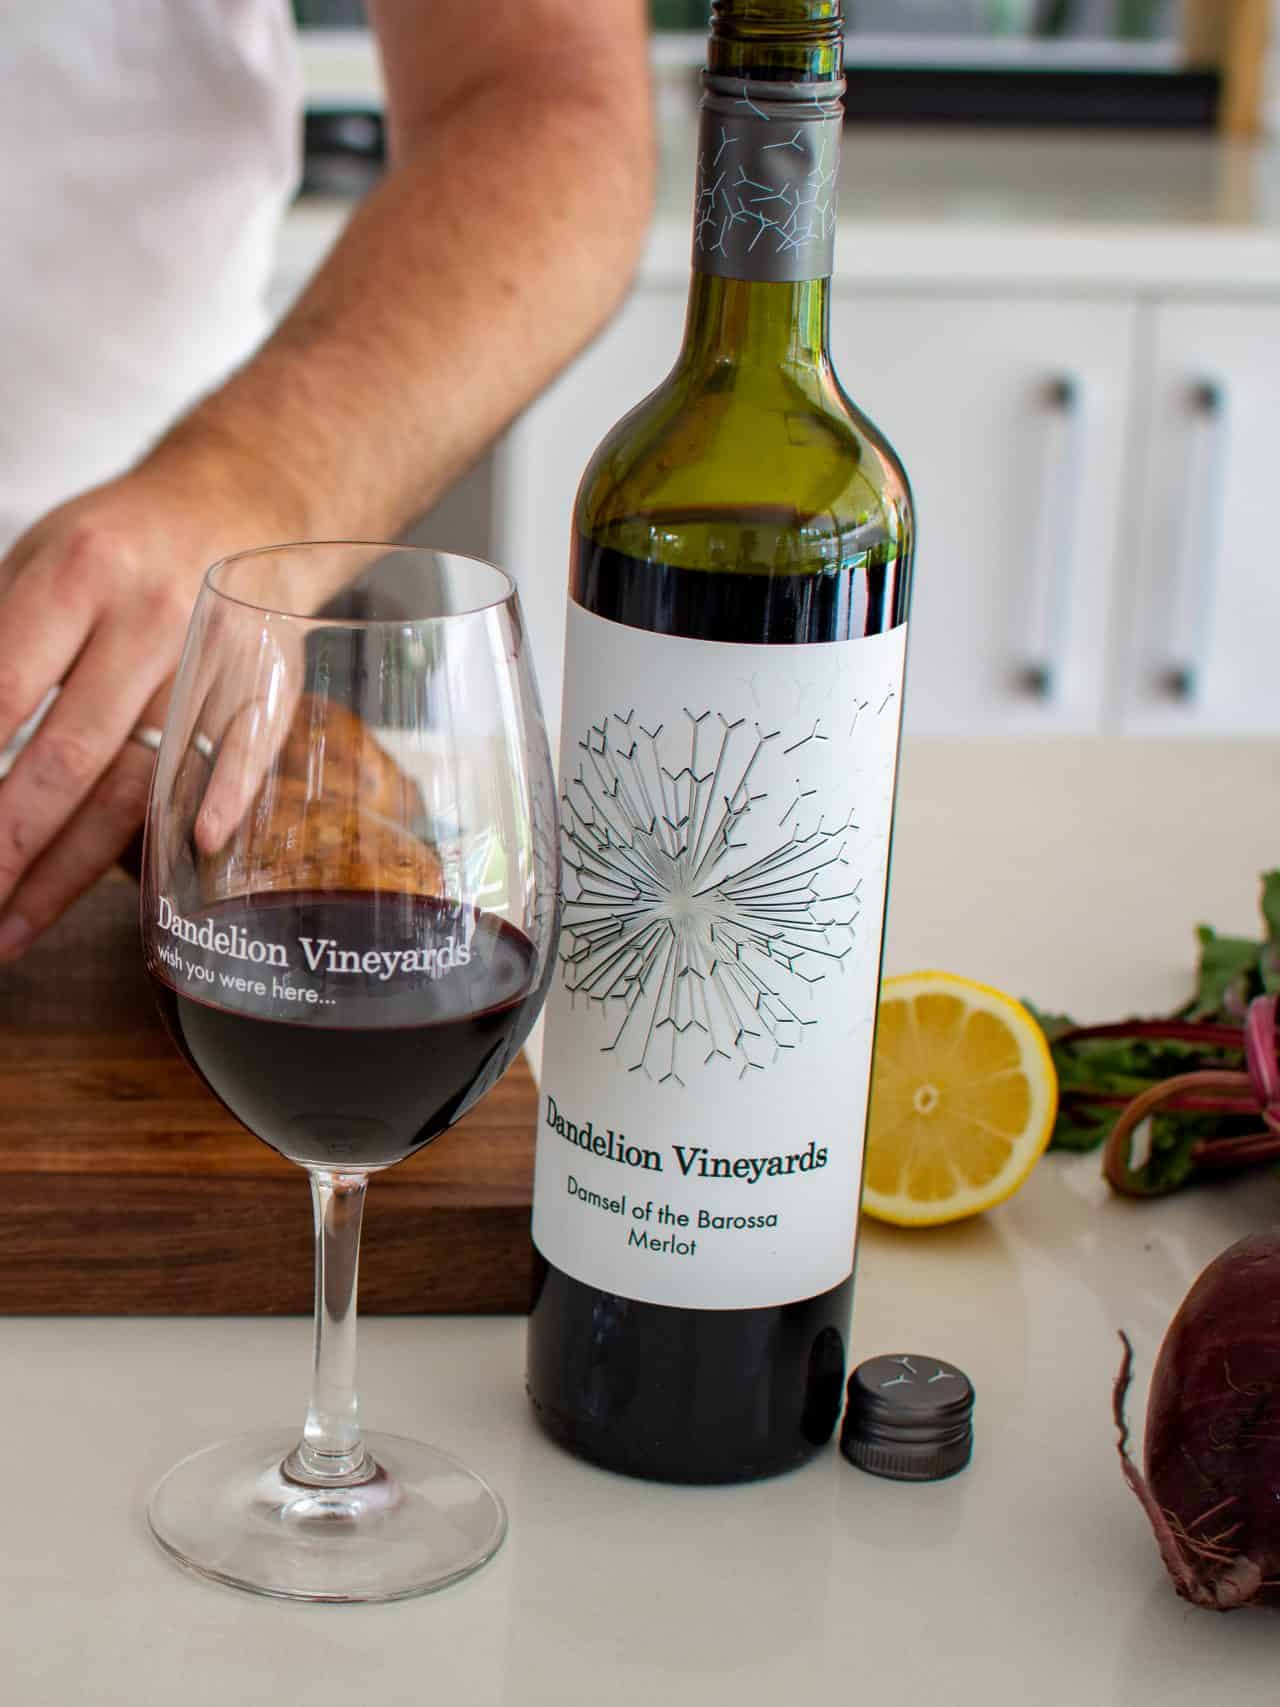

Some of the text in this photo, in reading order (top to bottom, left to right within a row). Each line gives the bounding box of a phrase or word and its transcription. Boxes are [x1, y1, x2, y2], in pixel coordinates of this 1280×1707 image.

[158, 896, 471, 980] Dandelion Vineyards
[158, 946, 337, 1005] wish you were here...
[546, 1095, 828, 1184] Dandelion Vineyards
[567, 1175, 778, 1230] Damsel of the Barossa
[628, 1227, 696, 1256] Merlot
